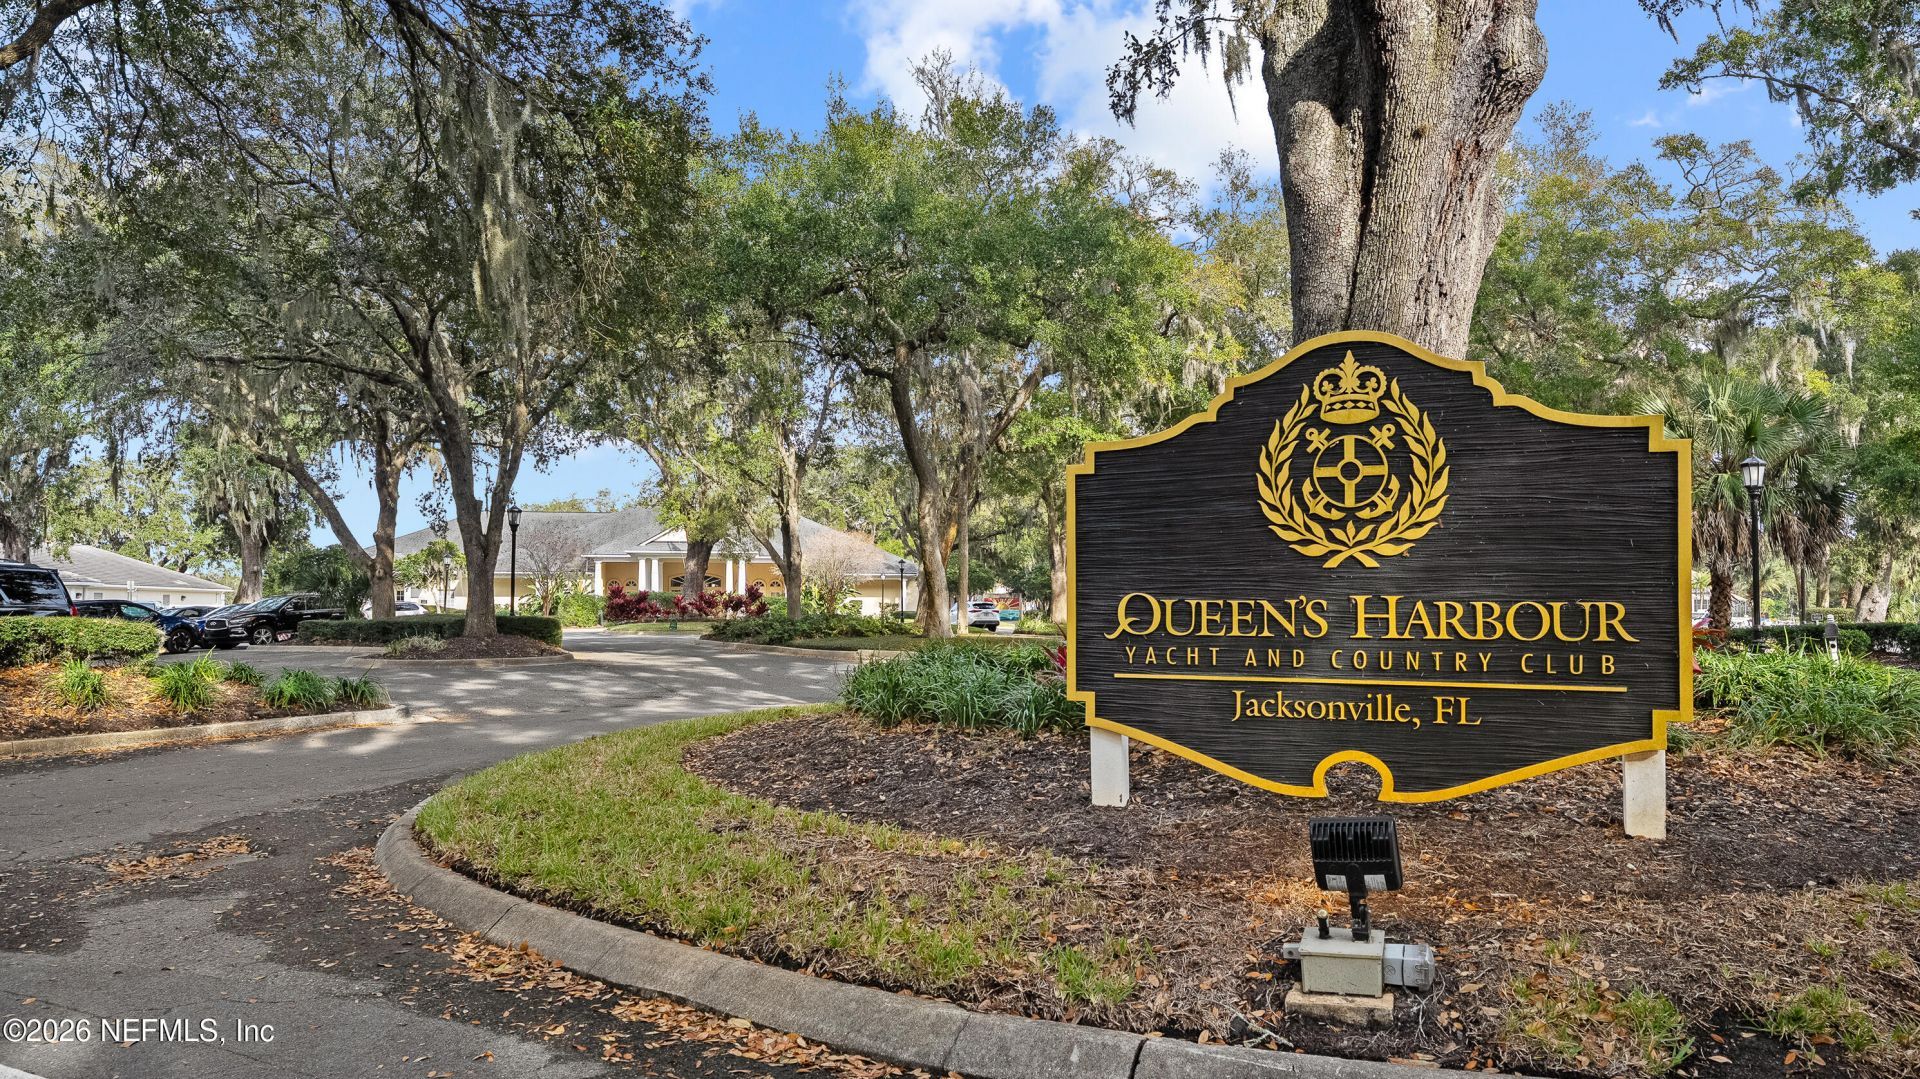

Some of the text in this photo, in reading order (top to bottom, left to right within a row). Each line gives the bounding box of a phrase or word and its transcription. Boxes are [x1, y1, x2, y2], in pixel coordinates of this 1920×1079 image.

[1104, 592, 1639, 643] QUEEN'S HARBOUR
[1125, 647, 1617, 676] YACHT AND COUNTRY CLUB
[1231, 690, 1482, 729] Jacksonville, FL
